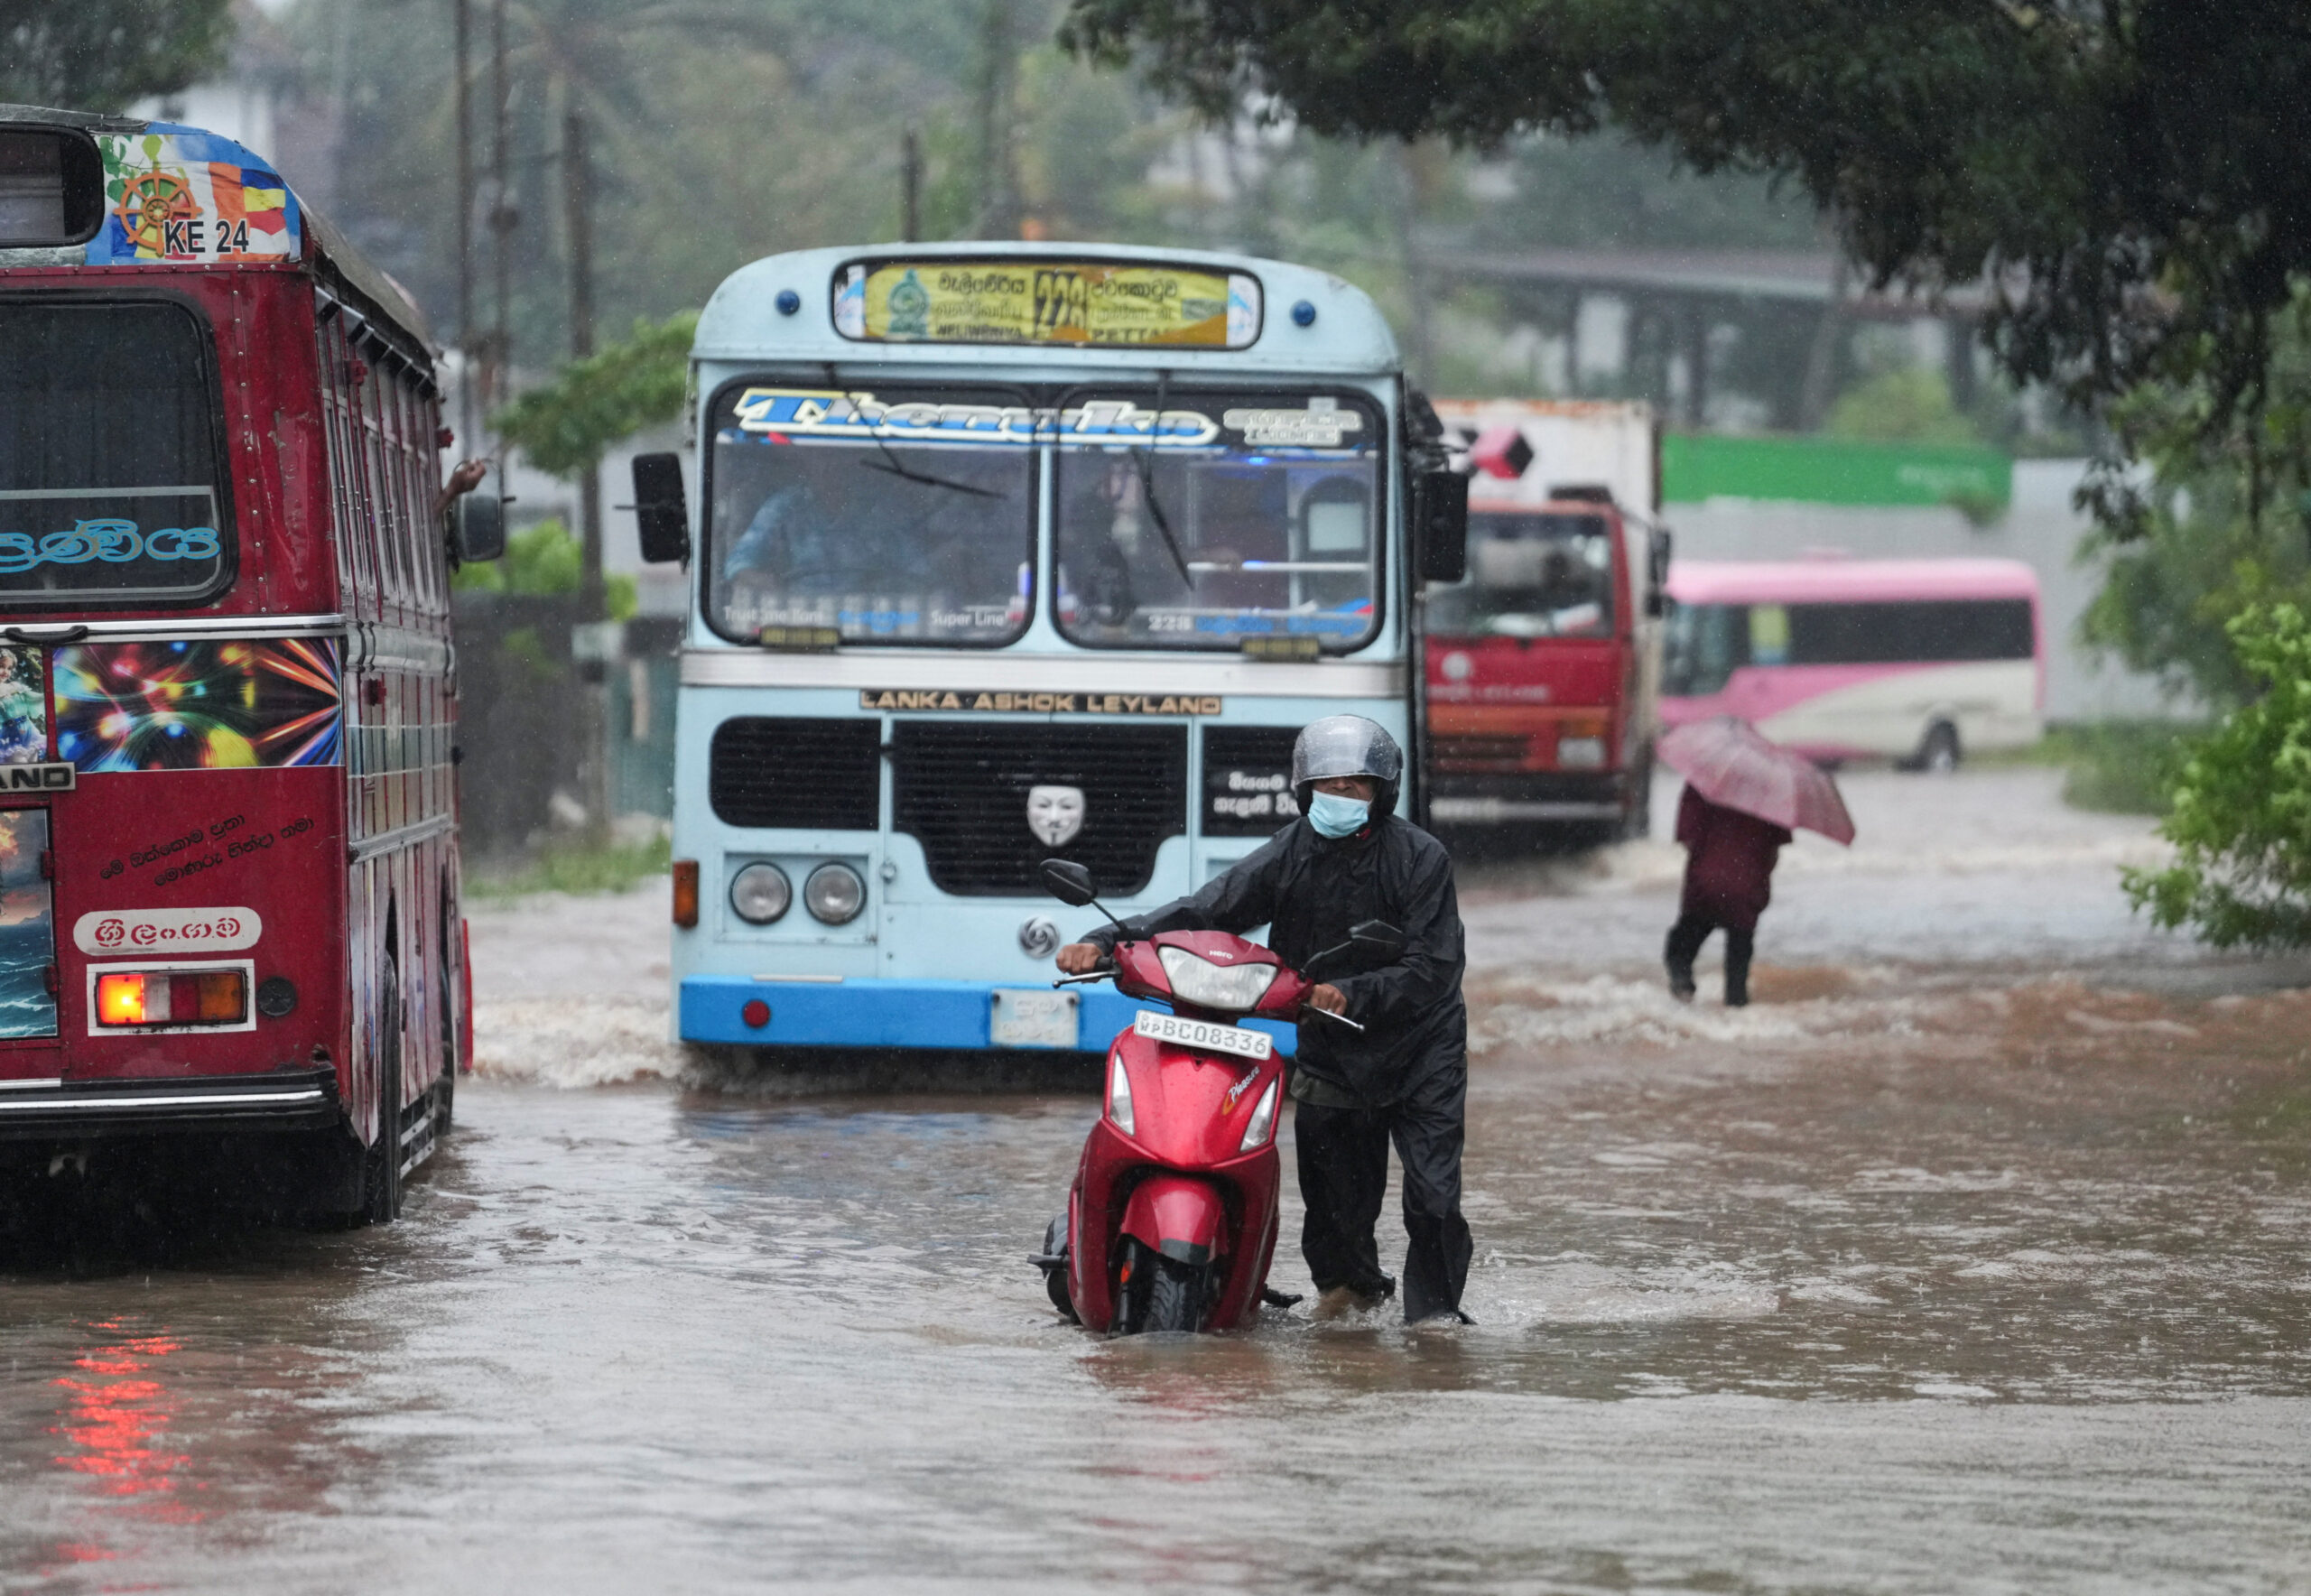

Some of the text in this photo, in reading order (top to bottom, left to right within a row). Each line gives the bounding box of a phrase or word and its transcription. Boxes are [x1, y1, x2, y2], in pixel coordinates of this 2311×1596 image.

[164, 219, 249, 253] KE 24
[931, 608, 971, 627] Super
[860, 691, 1222, 715] LANKA ASHOK LEYLAND
